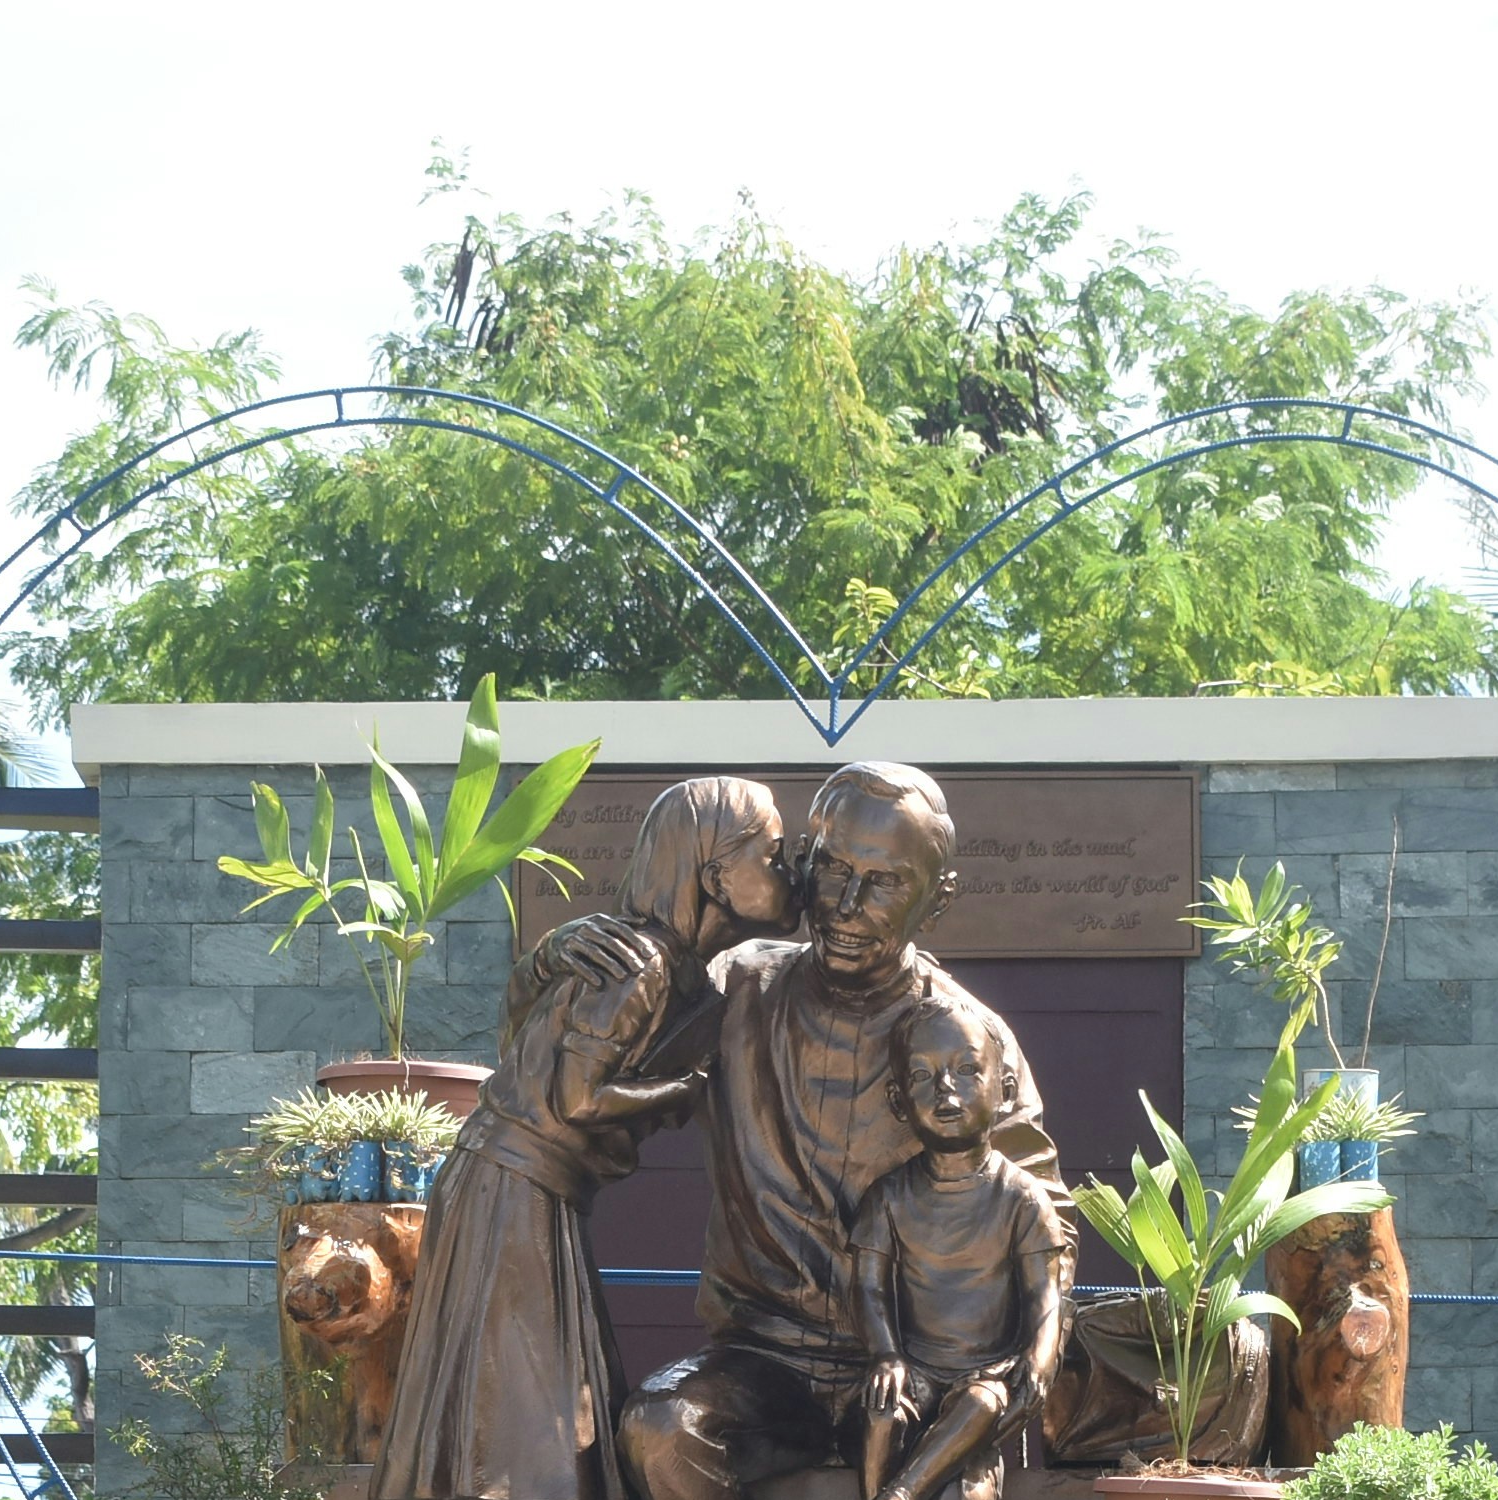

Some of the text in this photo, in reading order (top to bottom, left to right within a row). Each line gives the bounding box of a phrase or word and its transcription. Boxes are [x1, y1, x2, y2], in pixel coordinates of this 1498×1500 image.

[581, 805, 647, 824] childre
[582, 846, 614, 860] are
[1027, 840, 1048, 856] in
[1052, 838, 1083, 857] the
[573, 881, 593, 896] to
[1011, 876, 1042, 894] the
[1046, 874, 1108, 894] world
[1109, 874, 1131, 898] of
